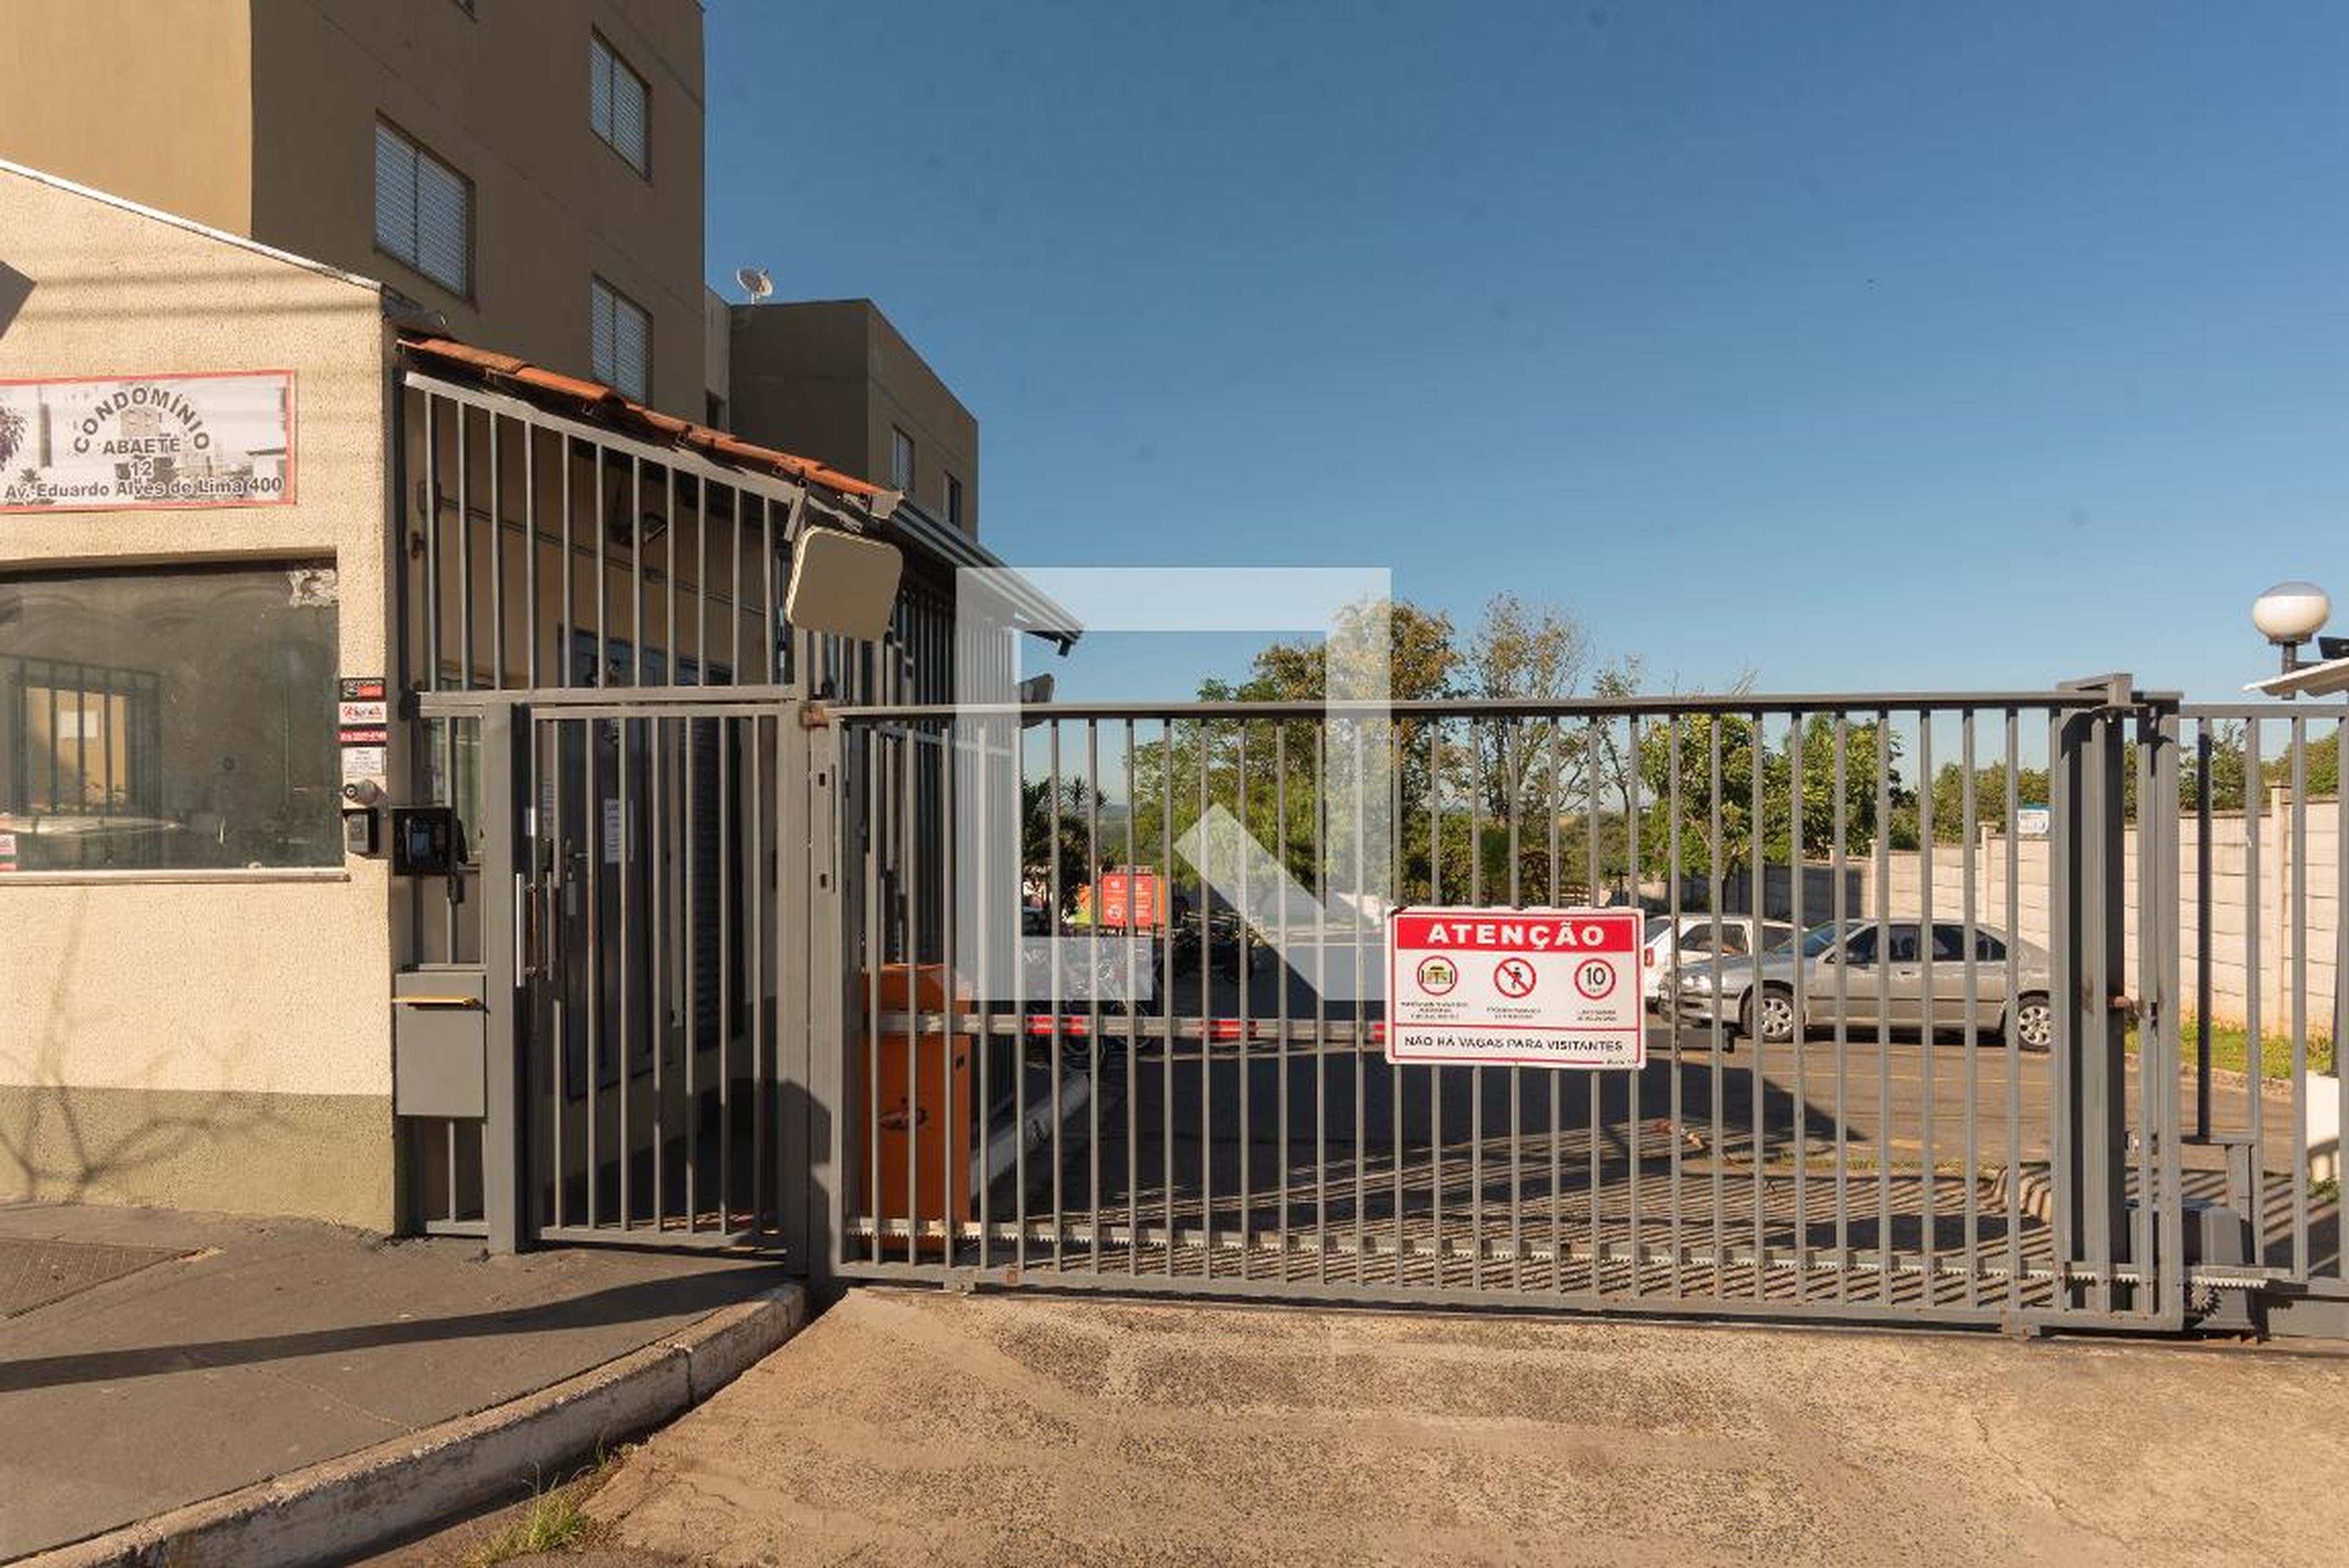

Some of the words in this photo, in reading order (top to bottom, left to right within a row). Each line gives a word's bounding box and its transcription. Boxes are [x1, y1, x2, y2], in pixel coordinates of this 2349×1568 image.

[73, 387, 210, 454] CONDOMÍNIO
[5, 484, 30, 498] Av.
[37, 481, 109, 497] Eduardo
[116, 480, 165, 495] Alves
[171, 481, 192, 494] de
[249, 476, 282, 492] 400
[1427, 922, 1605, 950] ATENÇÃO
[1586, 966, 1606, 986] 10
[1405, 1035, 1433, 1046] NÃO
[1438, 1035, 1456, 1047] HÁ
[1458, 1036, 1504, 1048] VAGAS
[1507, 1038, 1543, 1049] PARA
[1546, 1040, 1623, 1051] VISITANTES
